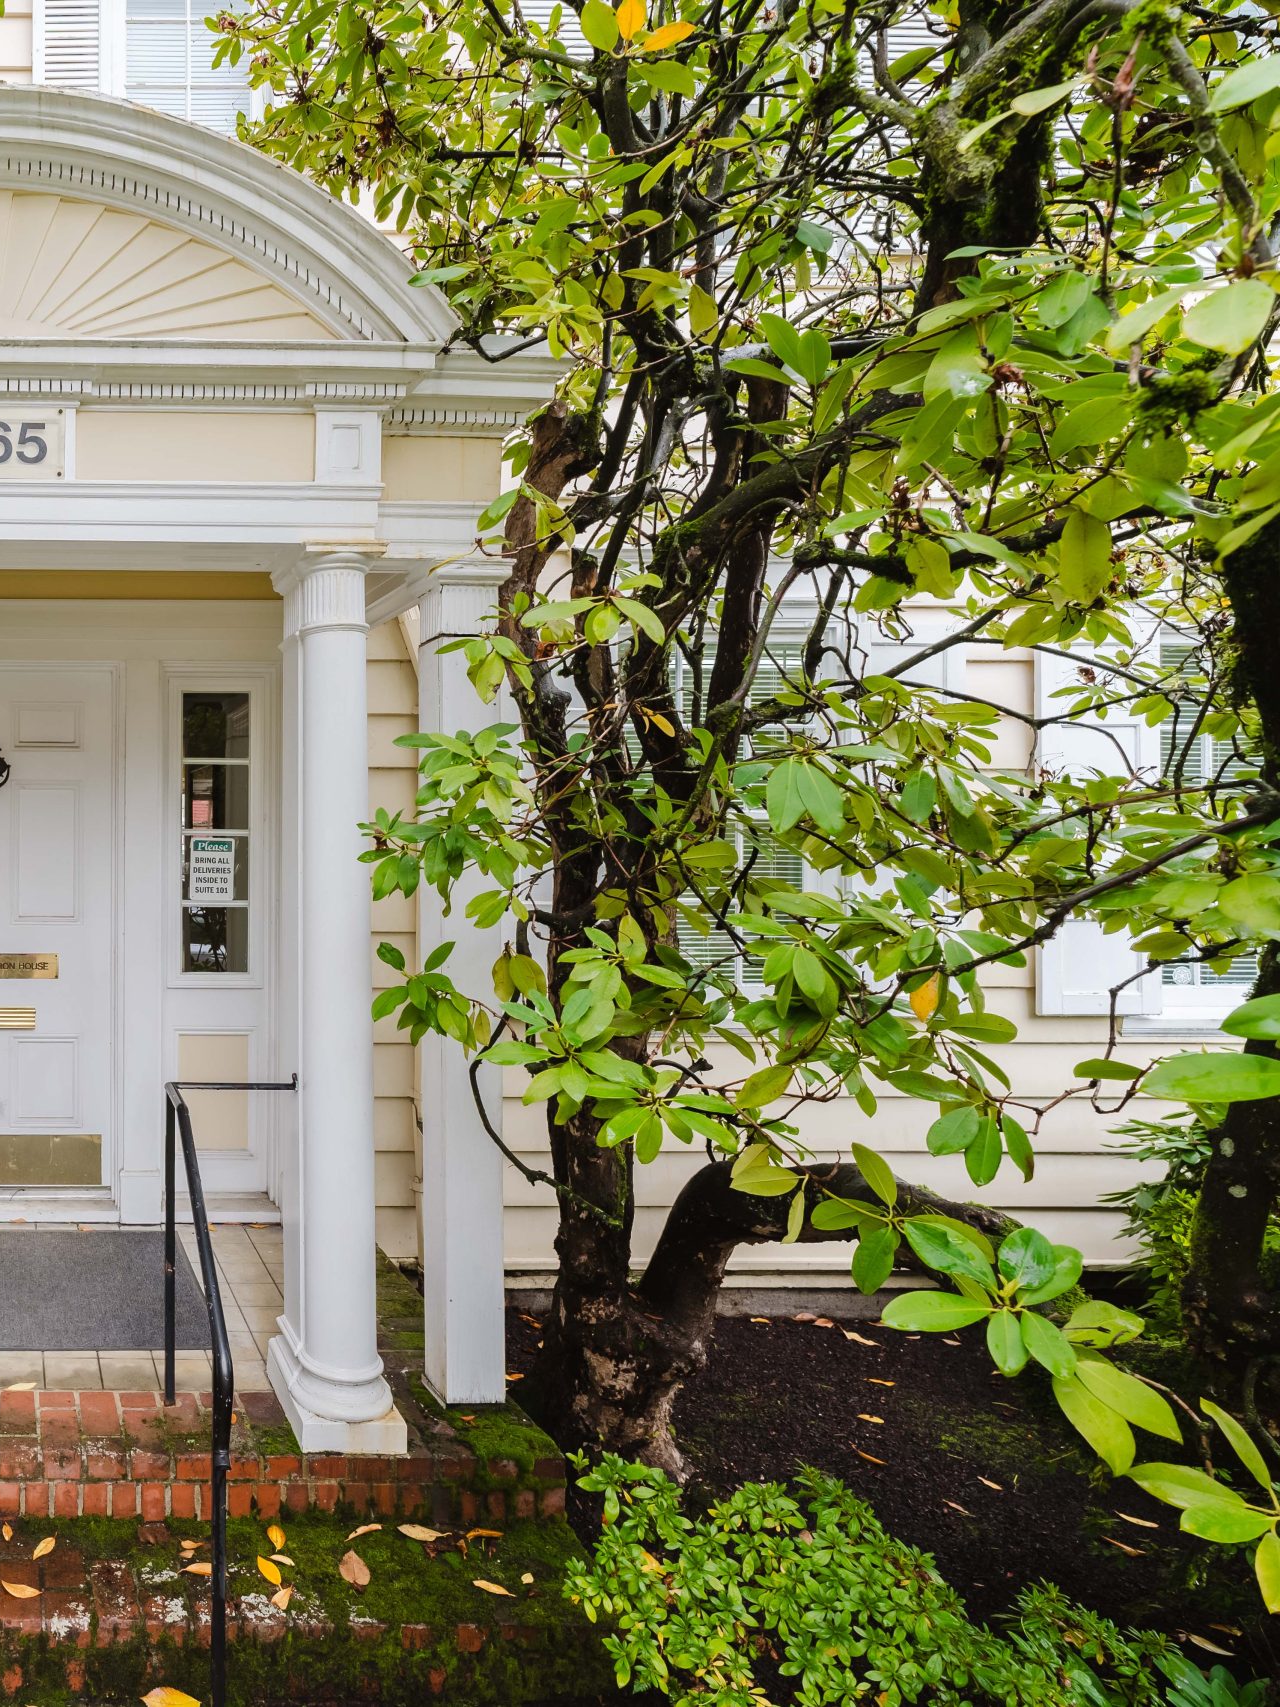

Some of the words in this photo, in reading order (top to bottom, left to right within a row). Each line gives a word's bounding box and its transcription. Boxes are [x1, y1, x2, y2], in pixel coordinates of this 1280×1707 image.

[197, 841, 229, 851] Please
[194, 856, 217, 864] BRING
[217, 857, 230, 865] ALL
[192, 866, 232, 874] DELIVERIES
[195, 876, 219, 884] INSIDE
[219, 876, 229, 884] TO
[194, 886, 215, 894] SUITE
[215, 886, 229, 894] 101
[18, 961, 49, 971] HOUSE
